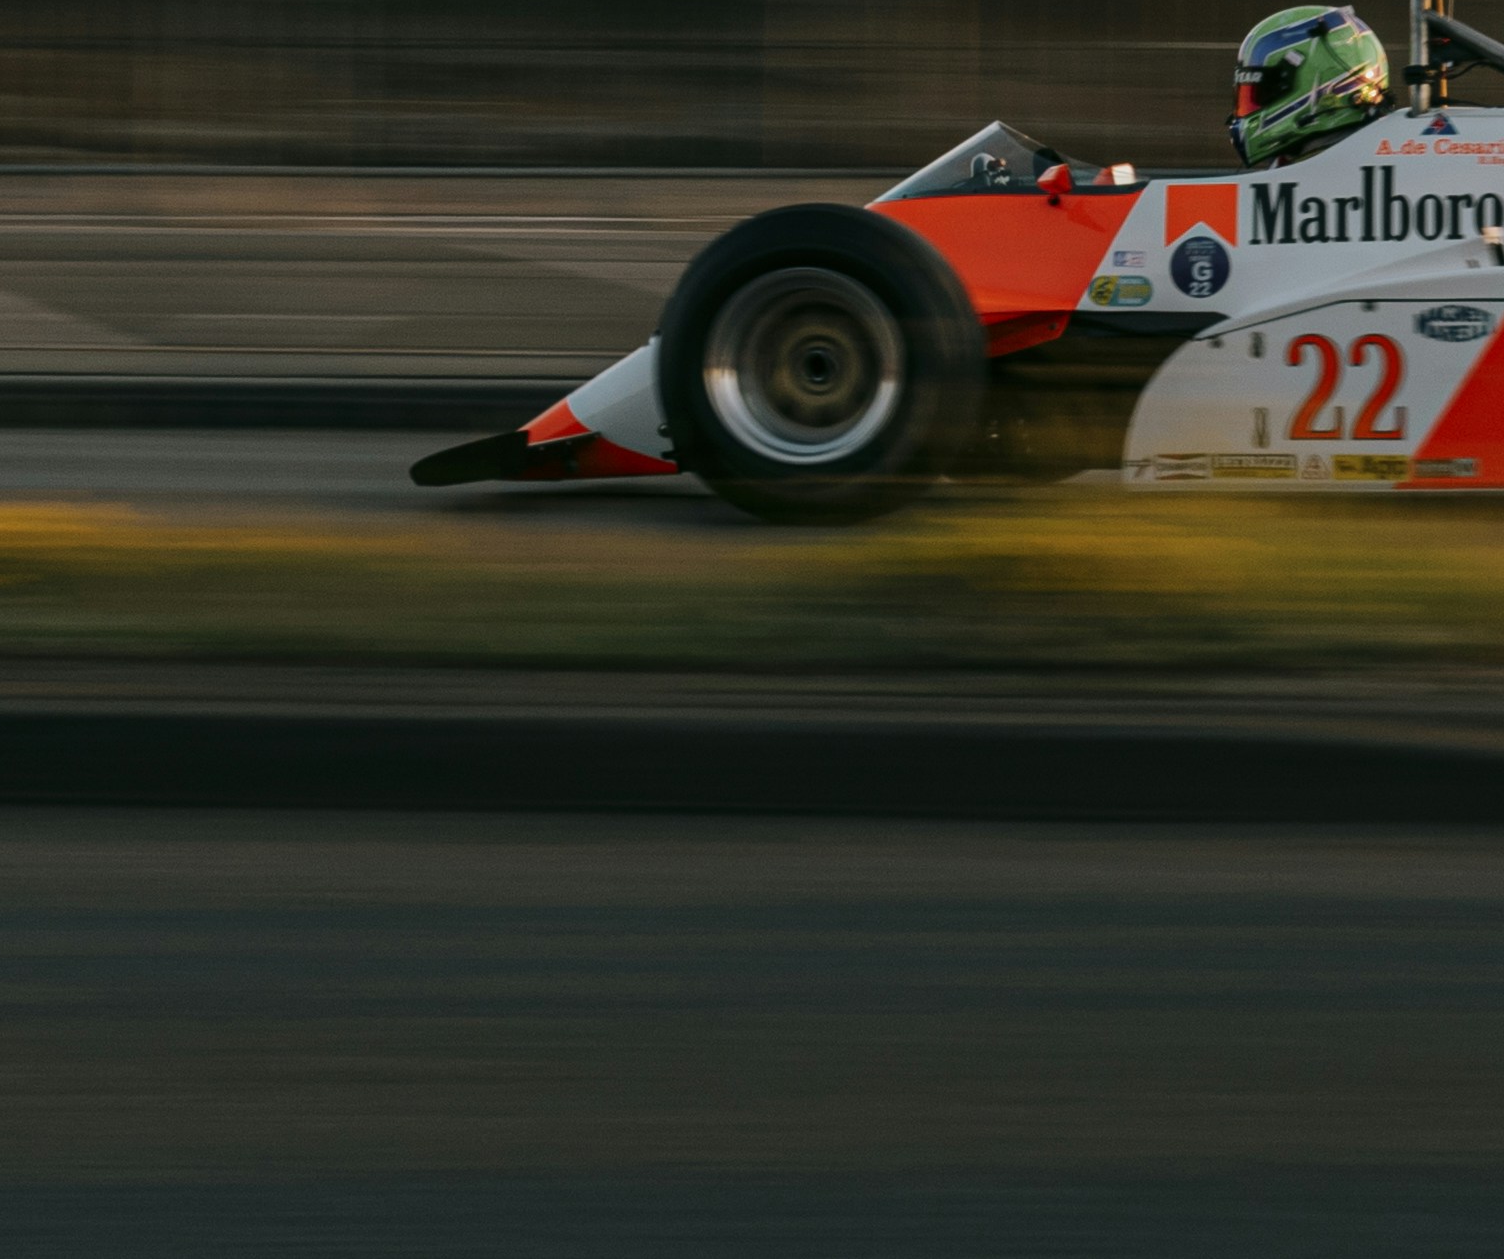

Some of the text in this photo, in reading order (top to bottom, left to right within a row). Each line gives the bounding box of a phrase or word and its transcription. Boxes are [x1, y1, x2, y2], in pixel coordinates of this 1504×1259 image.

[1191, 261, 1214, 281] G
[1188, 282, 1213, 296] 22
[1283, 333, 1407, 440] 22
